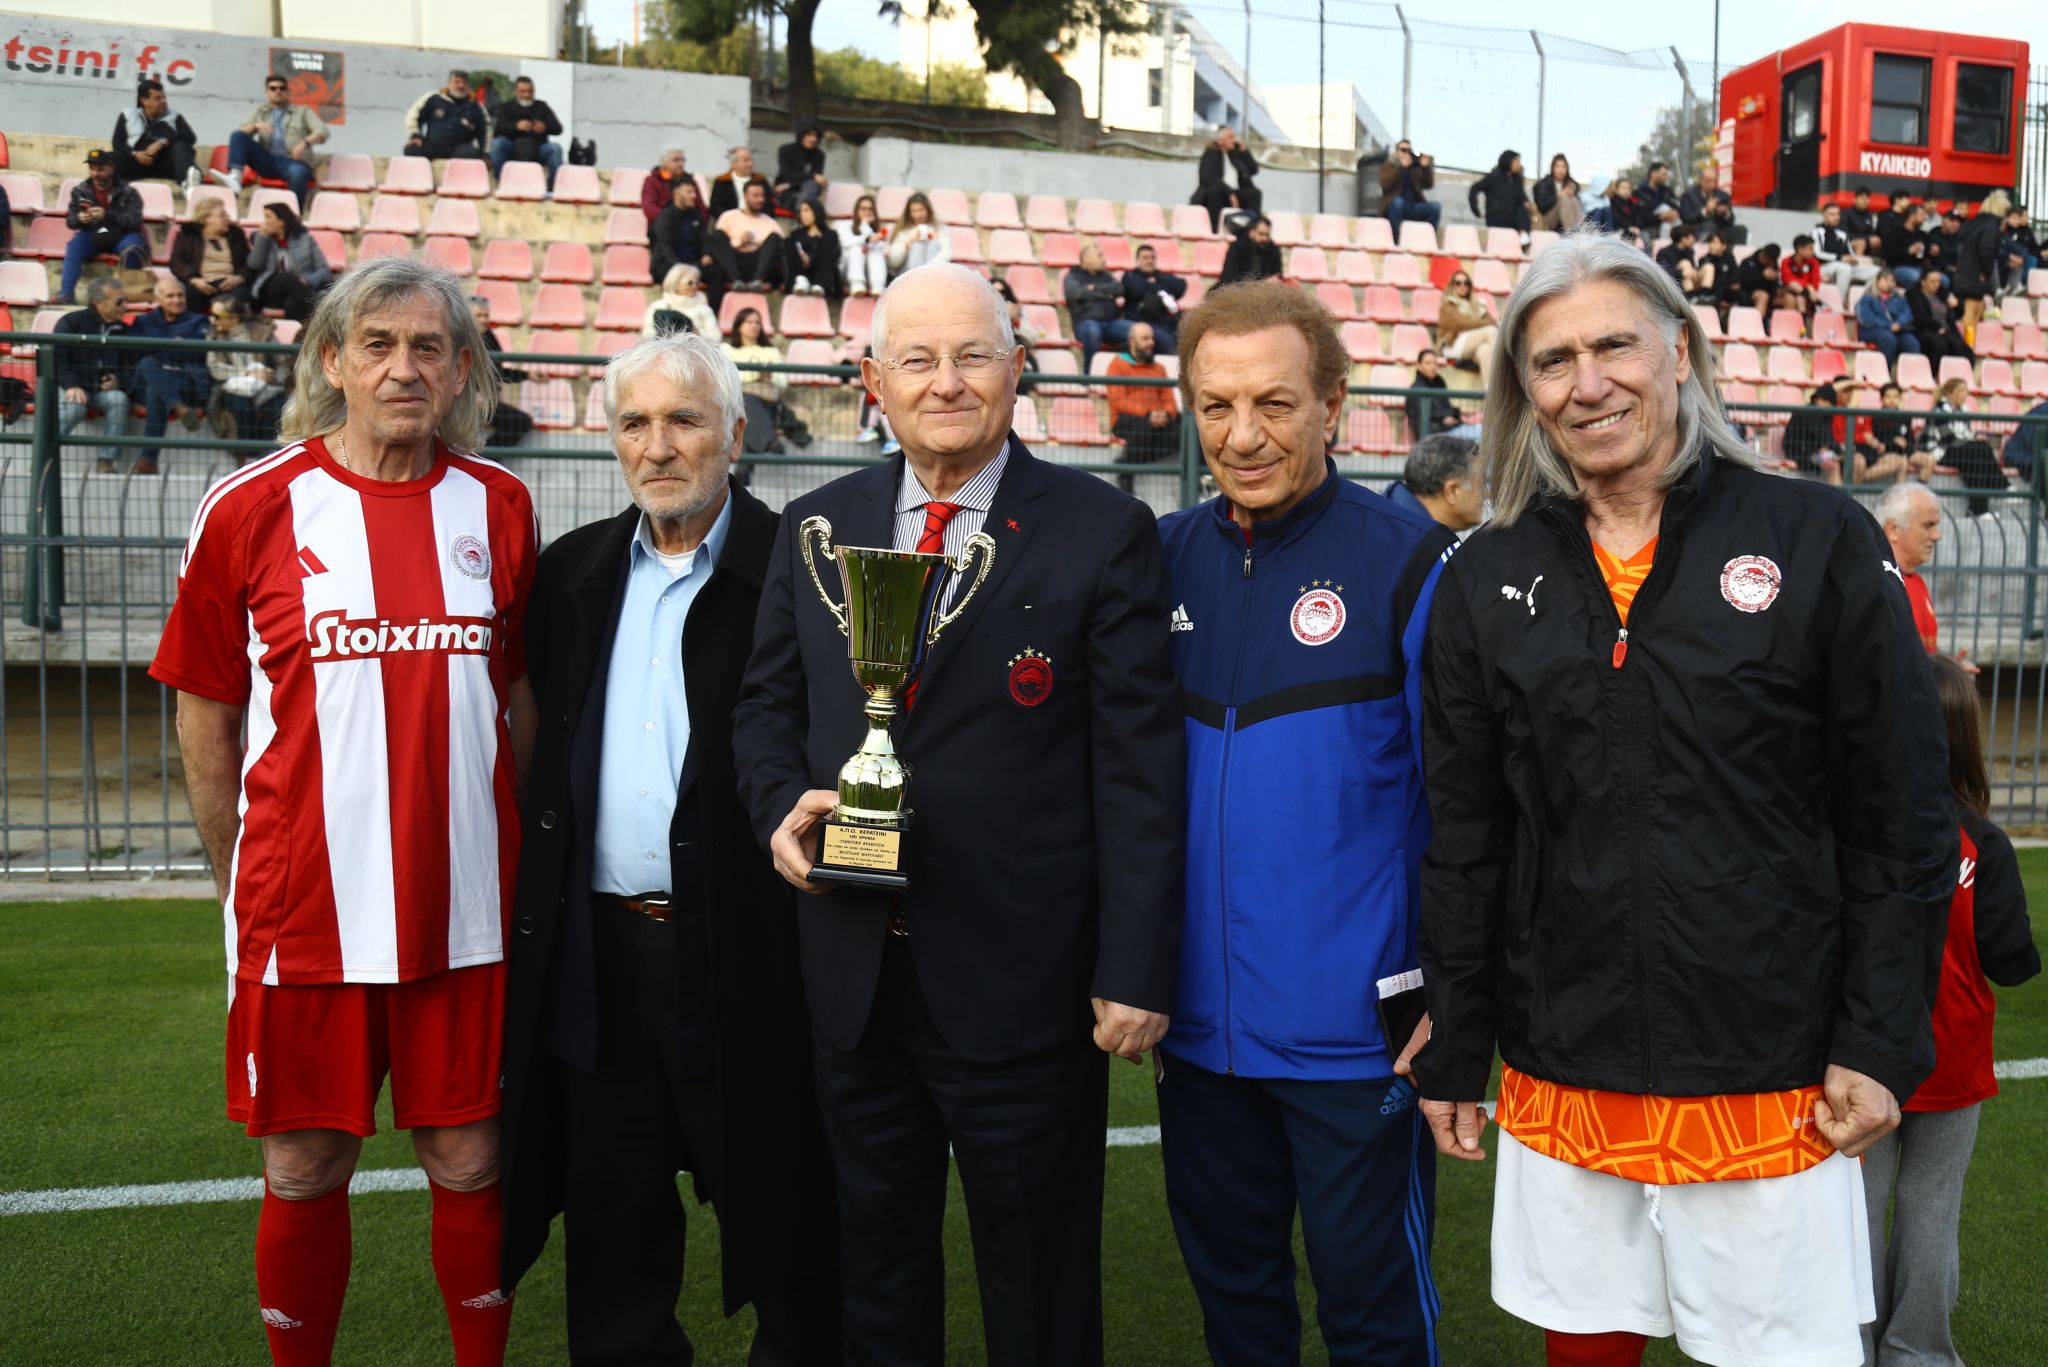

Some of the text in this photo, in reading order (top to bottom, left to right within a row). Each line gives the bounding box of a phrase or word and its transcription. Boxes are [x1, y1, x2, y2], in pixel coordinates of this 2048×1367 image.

[1, 35, 121, 79] tsini
[292, 60, 323, 71] WIN
[1860, 151, 1931, 178] ΚΥΛΙΚΕΙΟ
[311, 616, 492, 657] Stoiximan
[1380, 1095, 1416, 1115] adida
[461, 1295, 513, 1309] adida
